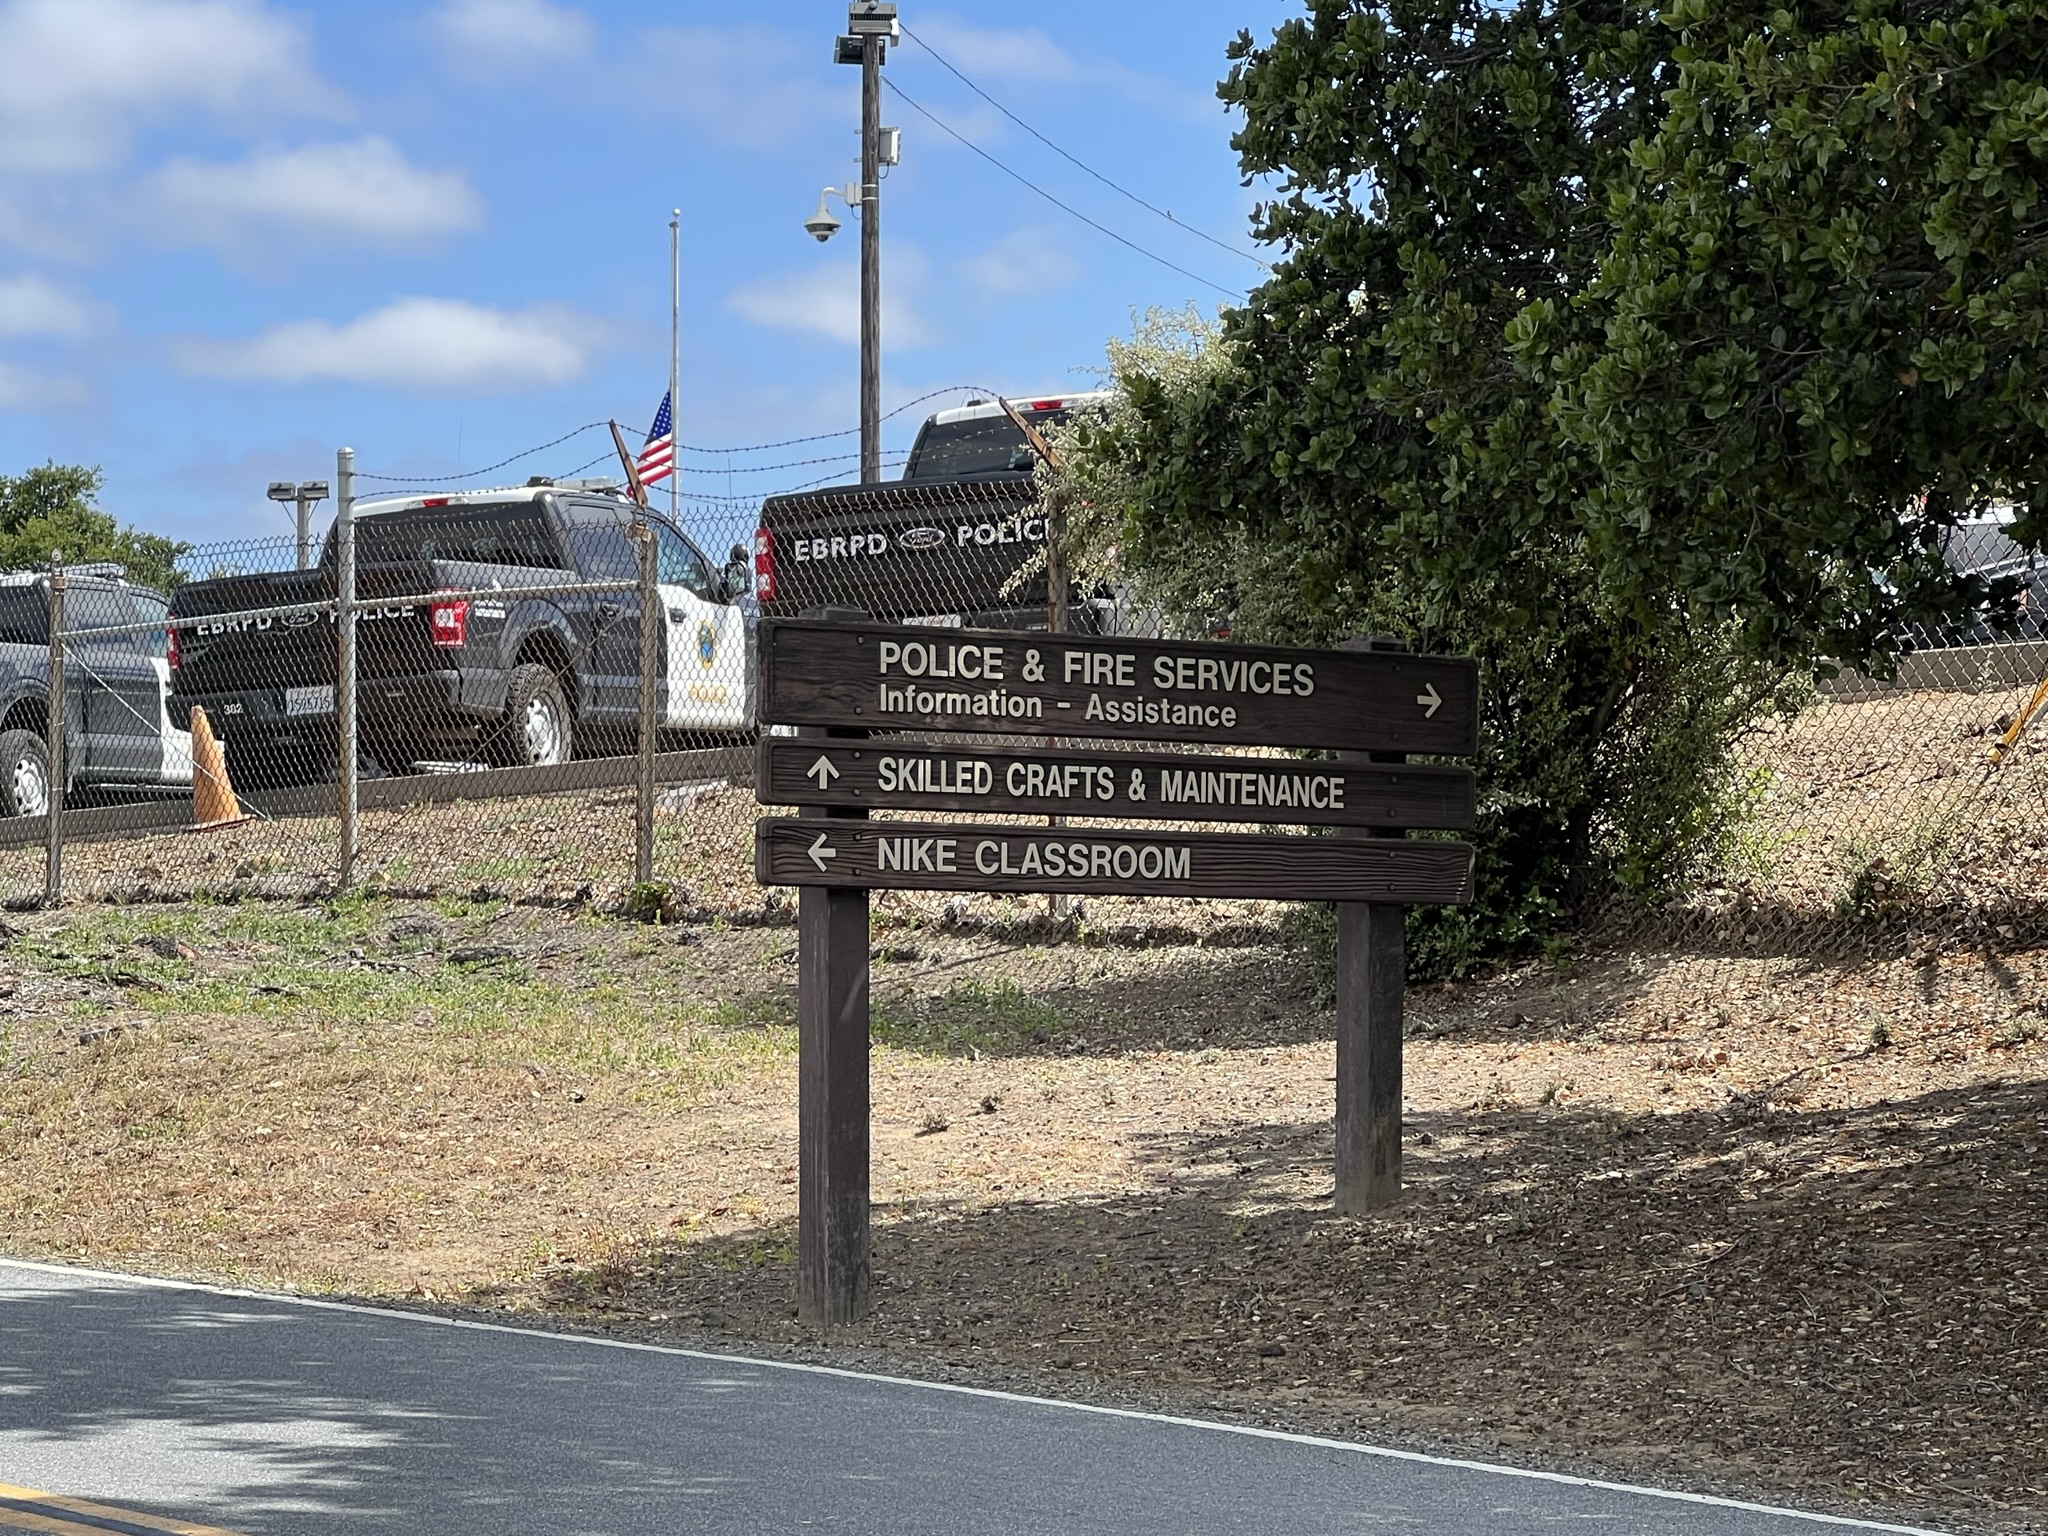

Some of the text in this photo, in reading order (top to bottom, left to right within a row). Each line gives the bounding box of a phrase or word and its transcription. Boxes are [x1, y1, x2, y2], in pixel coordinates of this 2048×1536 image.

[795, 533, 887, 561] EBRPD
[880, 641, 1314, 696] POLICE & FIRE SERVICES
[880, 683, 1042, 718] Information
[1084, 693, 1237, 728] Assistance
[878, 756, 1345, 809] SKILLED CRAFTS & MAINTENANCE
[878, 837, 1190, 879] NIKE CLASSROOM
